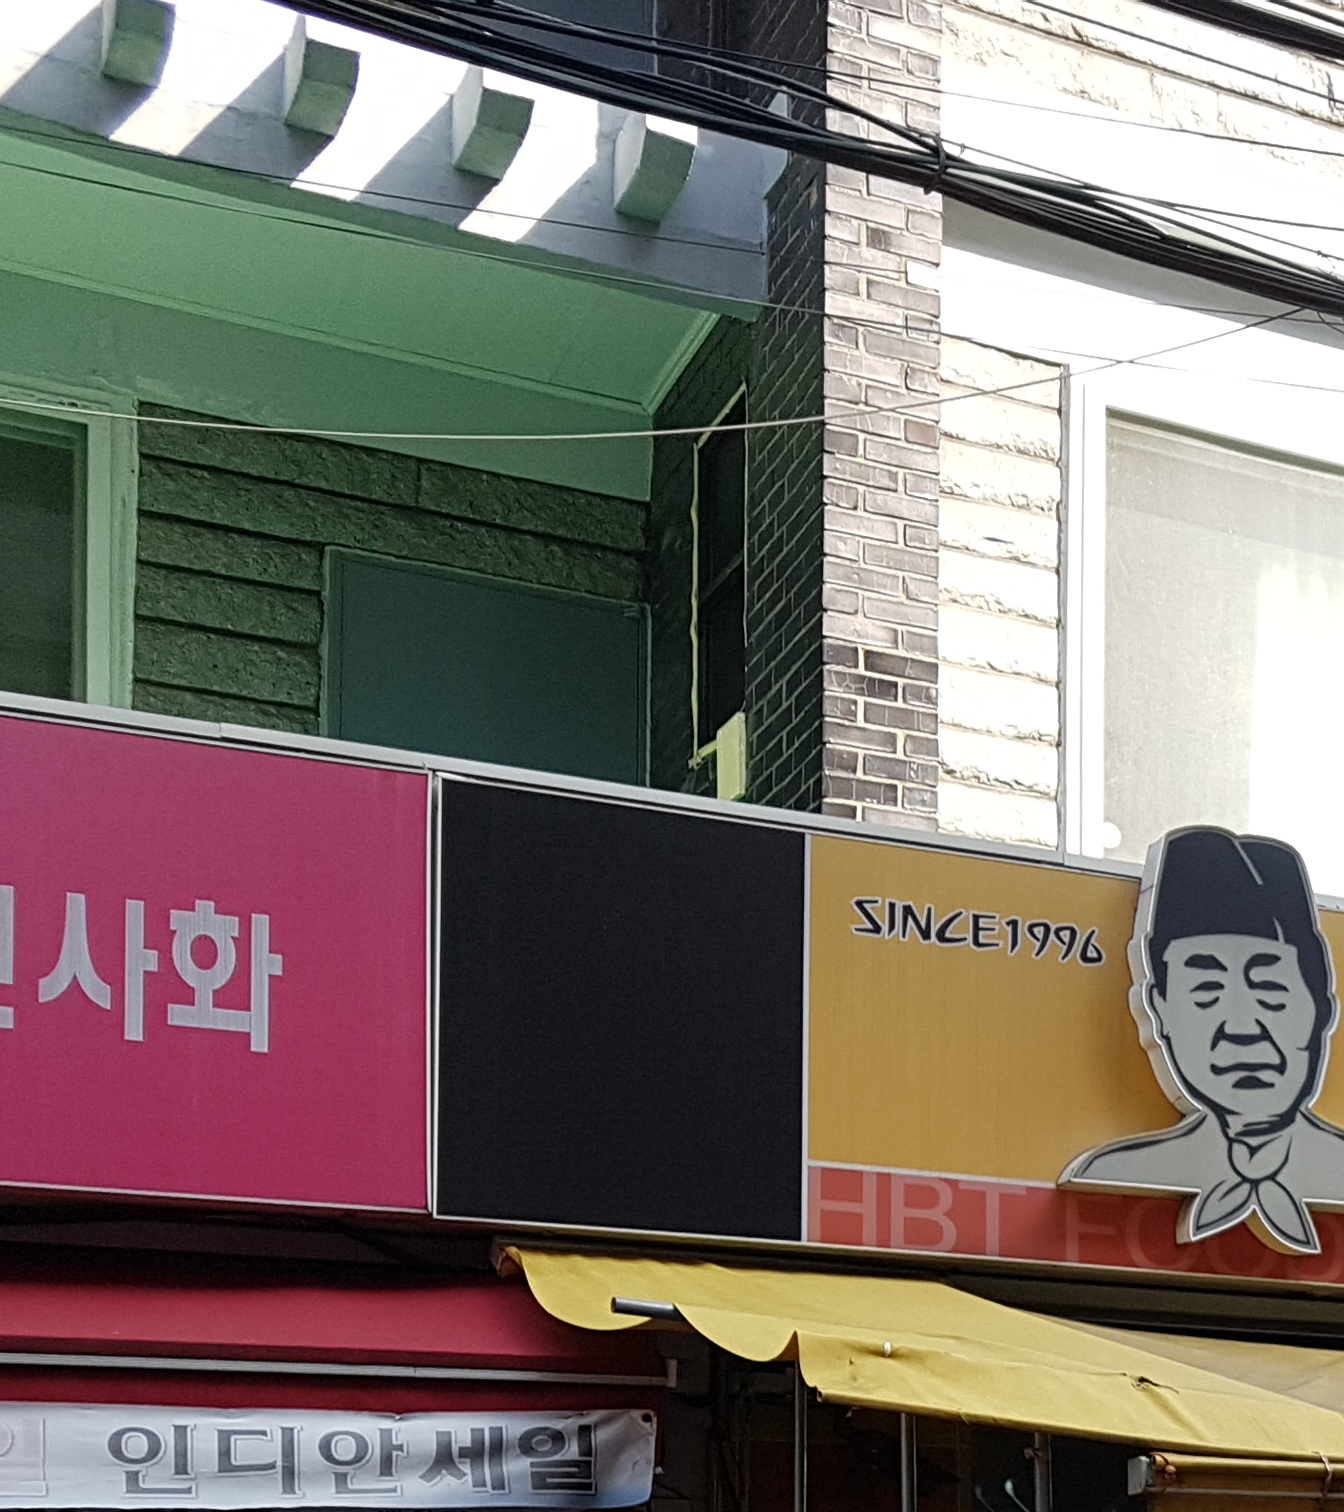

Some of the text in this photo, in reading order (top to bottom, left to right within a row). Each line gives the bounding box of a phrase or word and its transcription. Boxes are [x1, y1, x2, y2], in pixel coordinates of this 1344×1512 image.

[0, 885, 283, 1053] 사화
[850, 897, 1106, 966] SINCE1996
[808, 1167, 1026, 1254] HBT
[106, 1423, 598, 1497] 인디안세일
